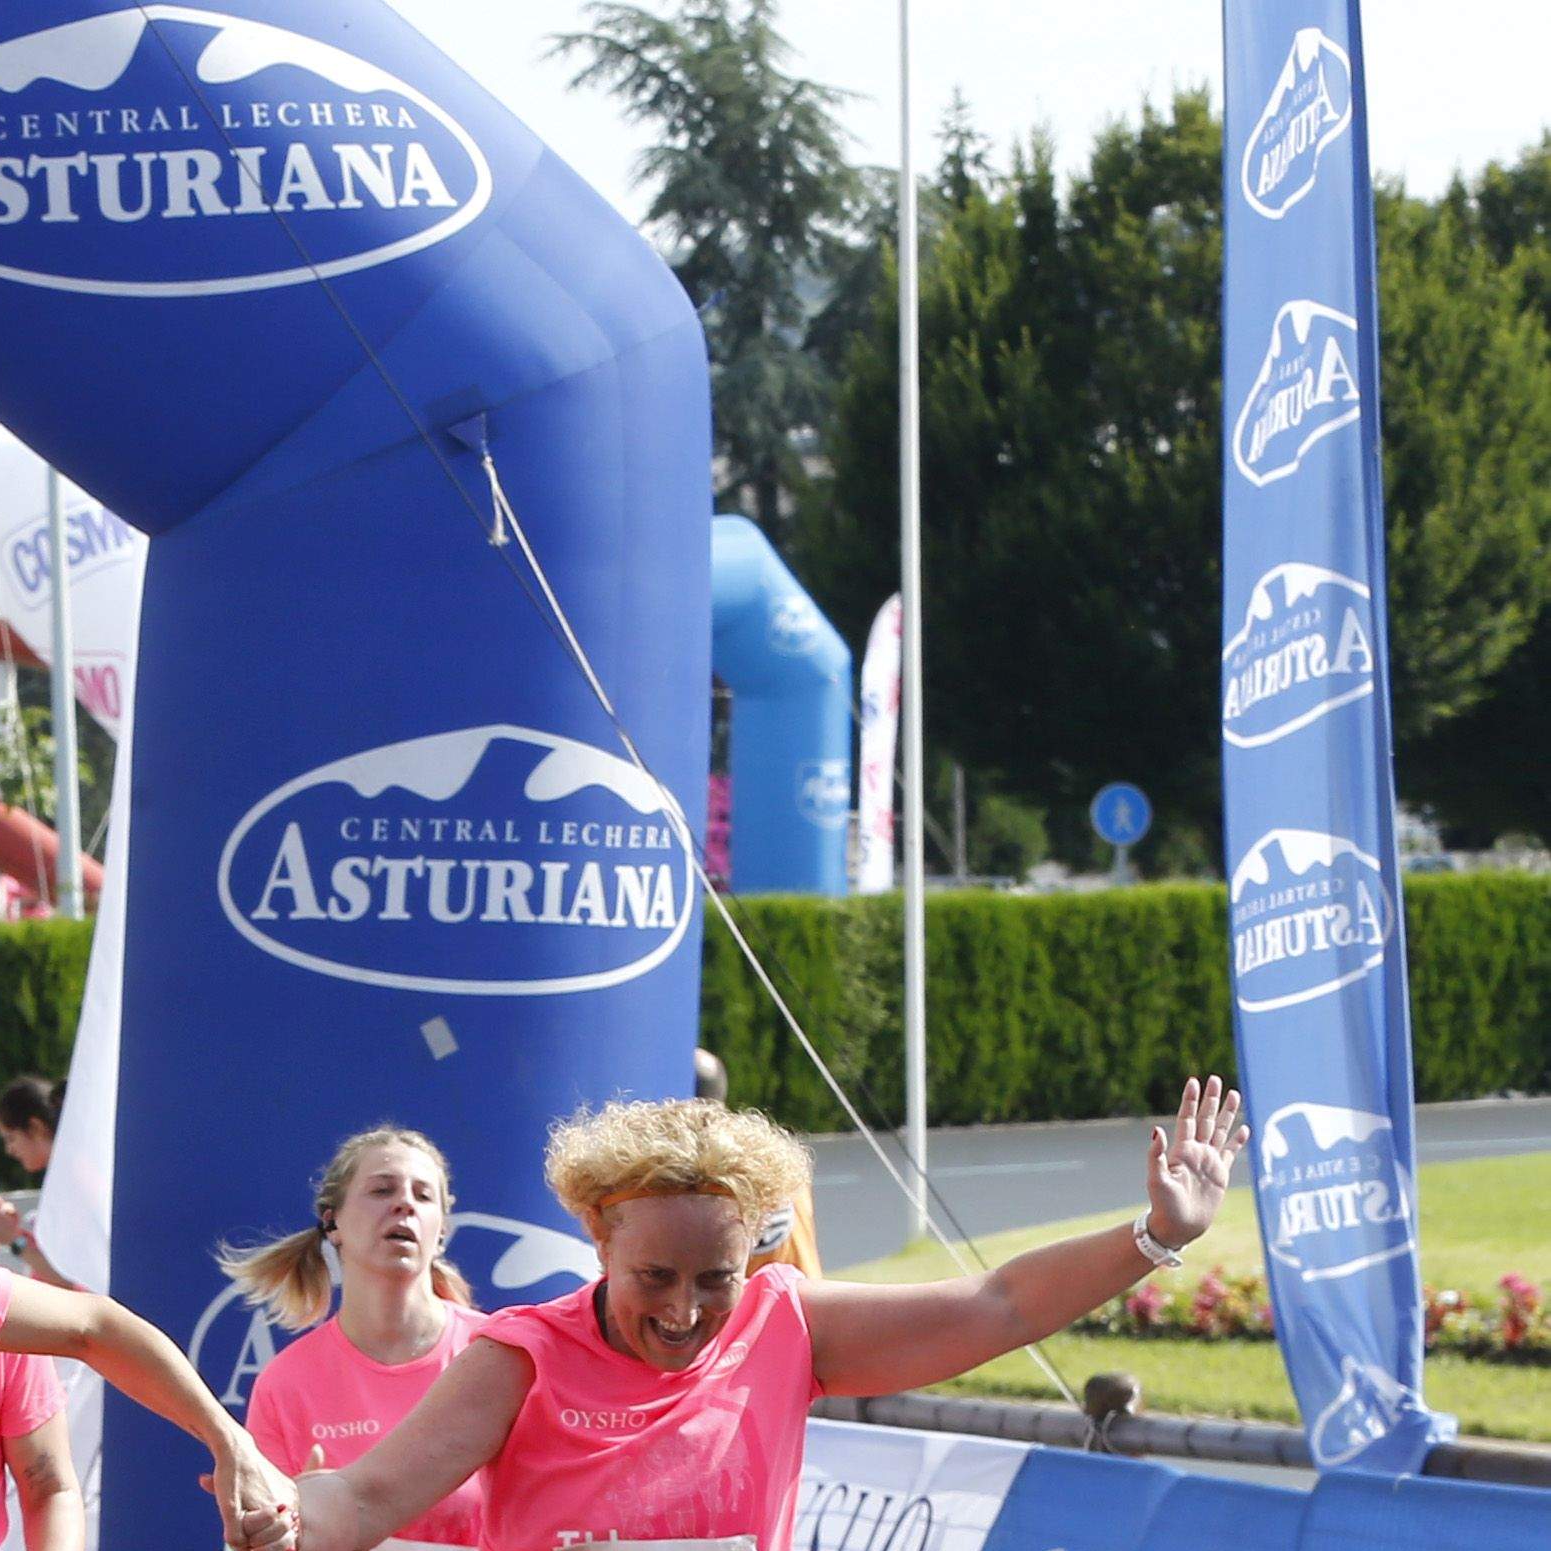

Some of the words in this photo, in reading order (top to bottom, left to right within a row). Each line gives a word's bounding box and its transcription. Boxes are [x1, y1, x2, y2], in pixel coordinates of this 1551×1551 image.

[221, 101, 418, 131] LECHERA
[340, 815, 523, 844] CENTRAL
[538, 820, 673, 852] LECHERA
[250, 821, 678, 930] ASTURIANA
[311, 1419, 381, 1440] OYSHO
[561, 1407, 647, 1430] OYSHO
